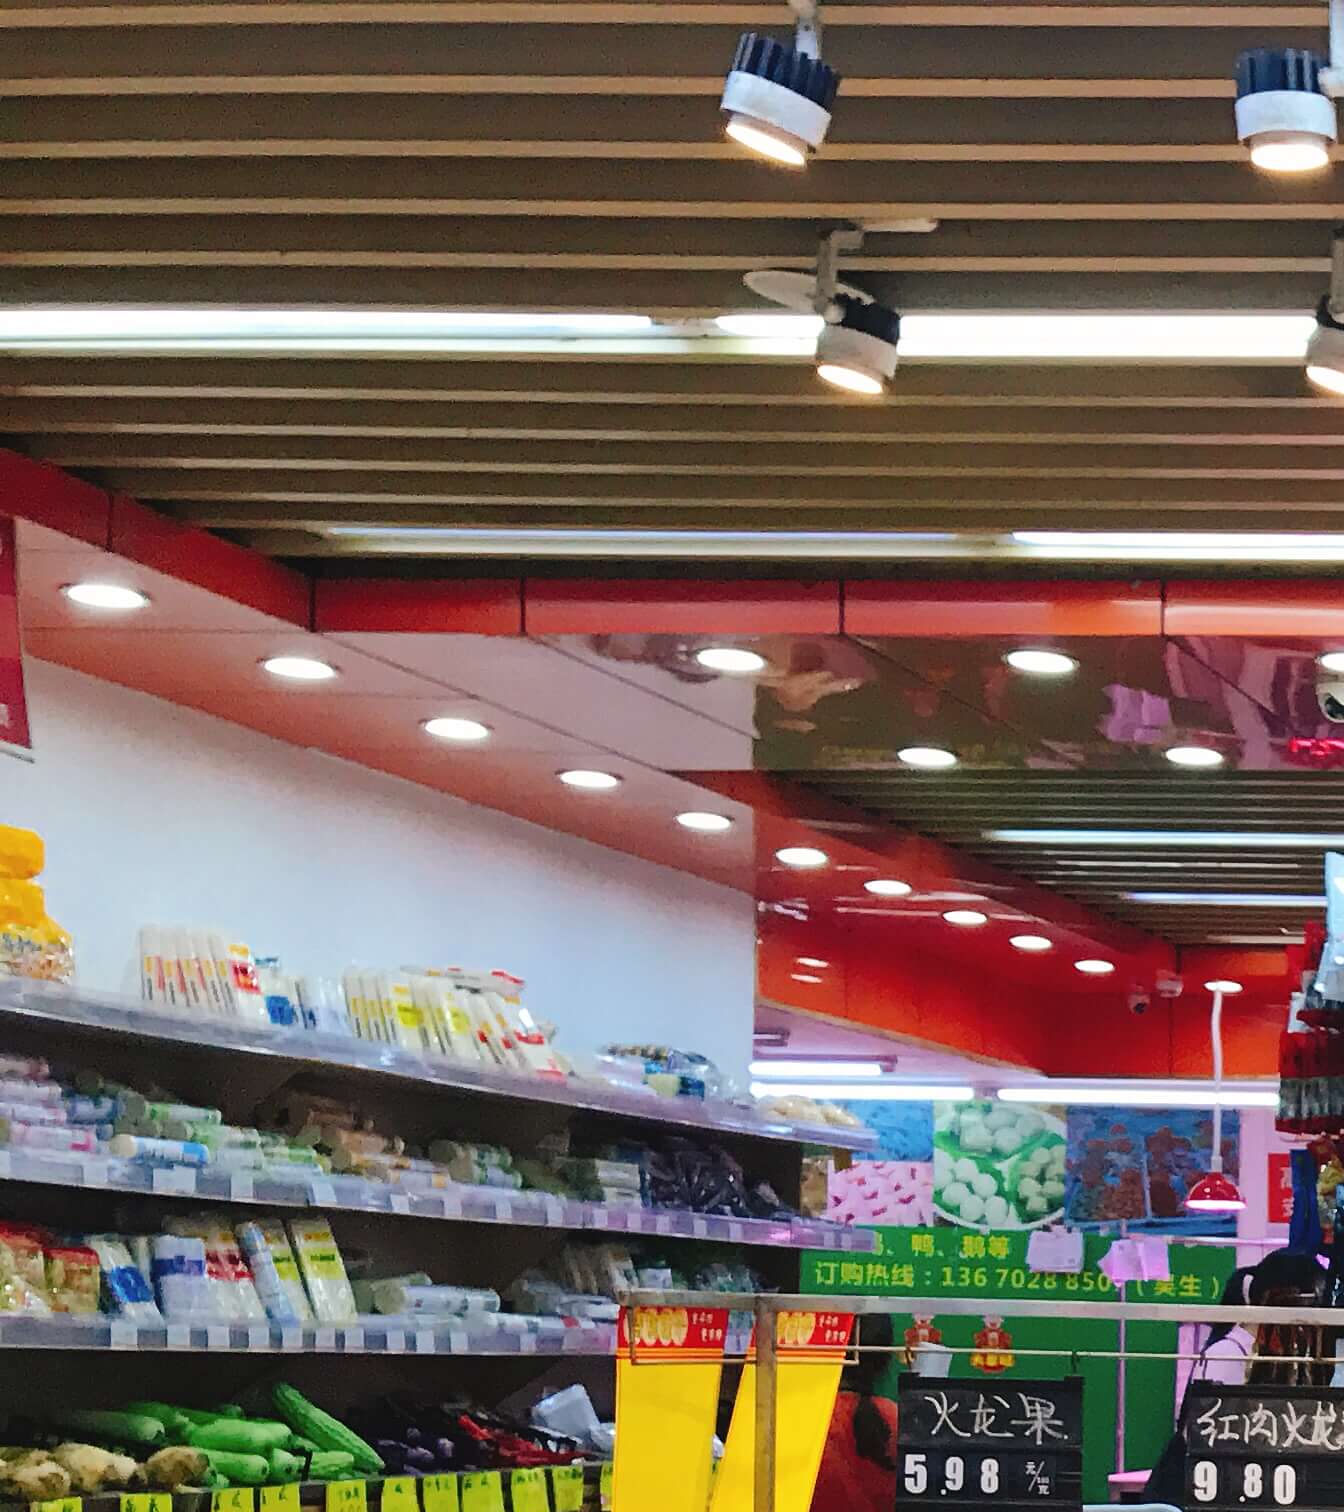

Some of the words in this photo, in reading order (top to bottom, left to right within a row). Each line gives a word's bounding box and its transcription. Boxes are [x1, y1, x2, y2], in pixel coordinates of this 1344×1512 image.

[943, 1267, 987, 1287] 136
[1000, 1268, 1058, 1289] 7028
[925, 1393, 1069, 1444] 火龙果
[904, 1454, 998, 1495] 5.98
[1193, 1461, 1296, 1504] 9.80
